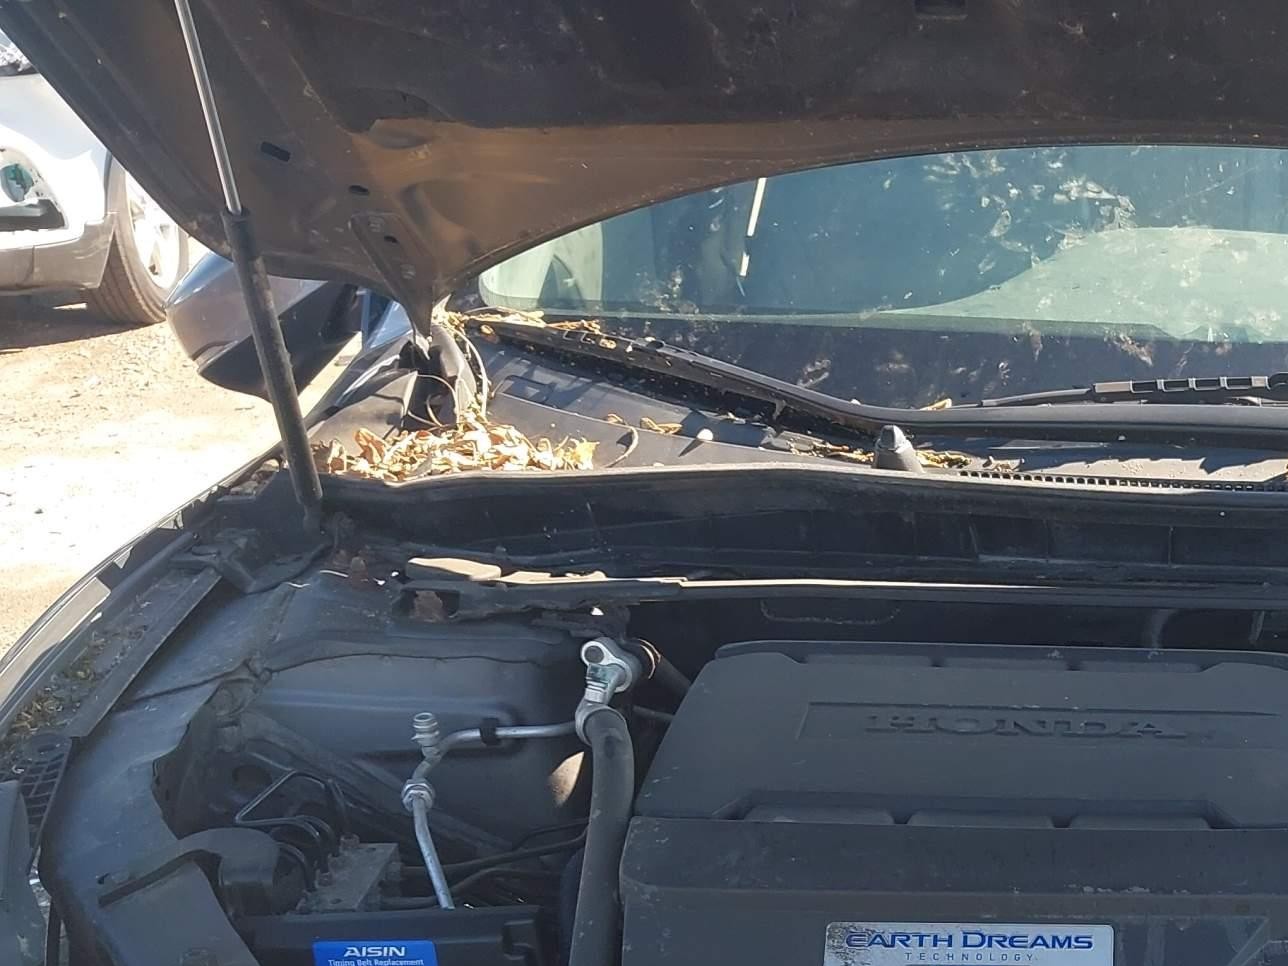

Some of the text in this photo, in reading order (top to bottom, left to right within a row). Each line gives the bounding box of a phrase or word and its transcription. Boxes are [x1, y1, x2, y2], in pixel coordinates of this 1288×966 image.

[866, 715, 1187, 739] HONDA
[846, 931, 1094, 950] EARTH DREAMS
[343, 946, 406, 957] AISIN
[904, 952, 1033, 962] TECHNOLOGY
[357, 959, 373, 966] Belt
